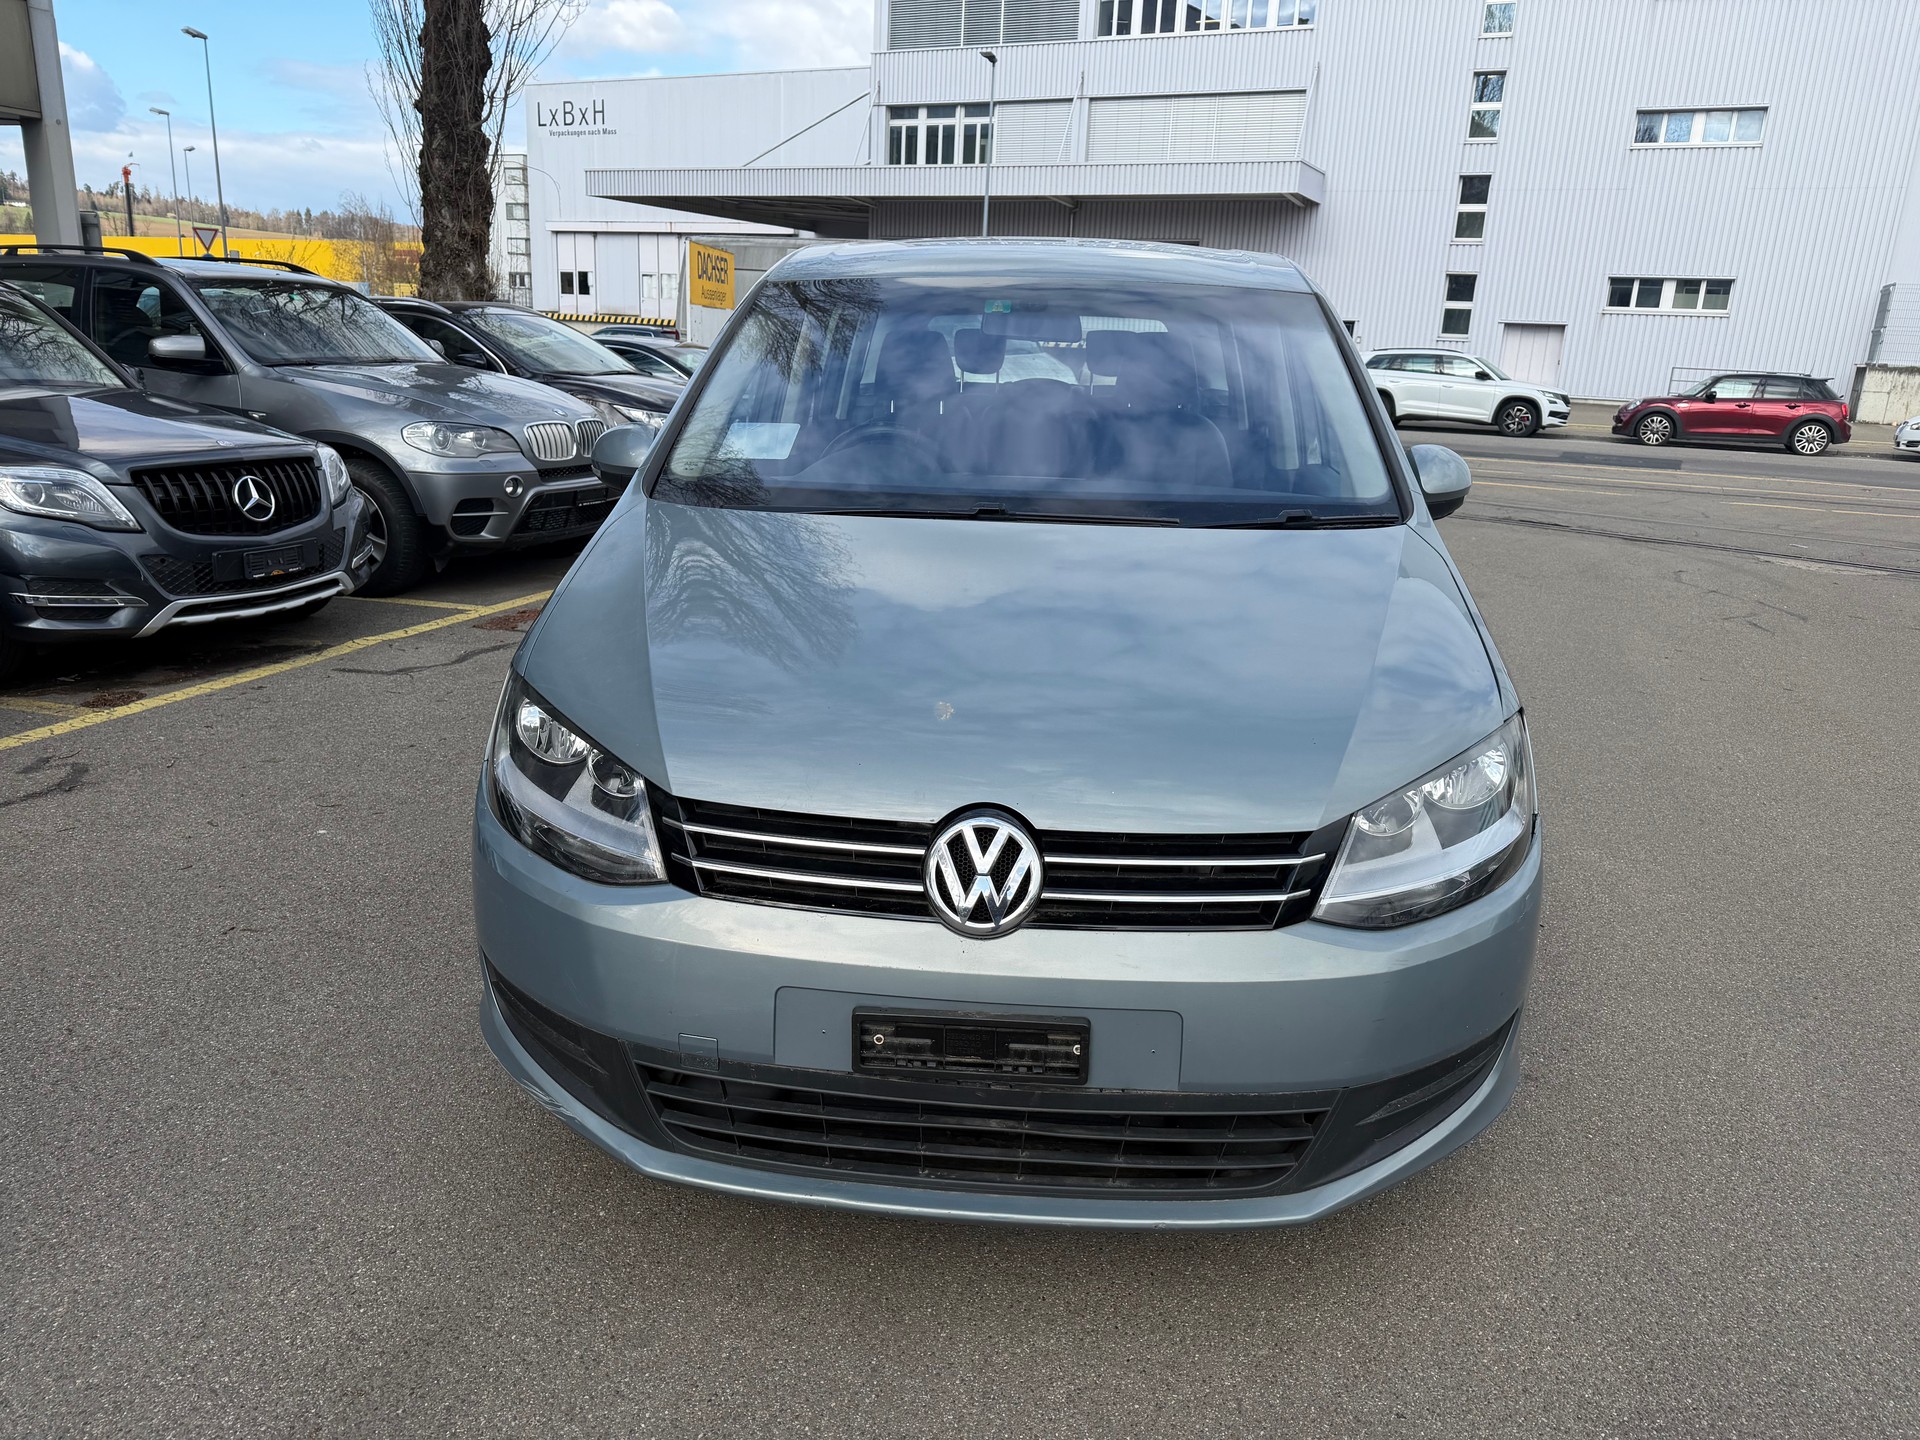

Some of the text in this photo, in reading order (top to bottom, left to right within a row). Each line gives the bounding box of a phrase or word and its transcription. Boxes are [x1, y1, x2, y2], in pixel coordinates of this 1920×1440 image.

[537, 98, 605, 127] LxBxH
[548, 127, 617, 138] Verpackungen nach Mass
[697, 250, 729, 285] DACHSER
[701, 285, 727, 306] Aussenlager
[932, 820, 1036, 930] VW
